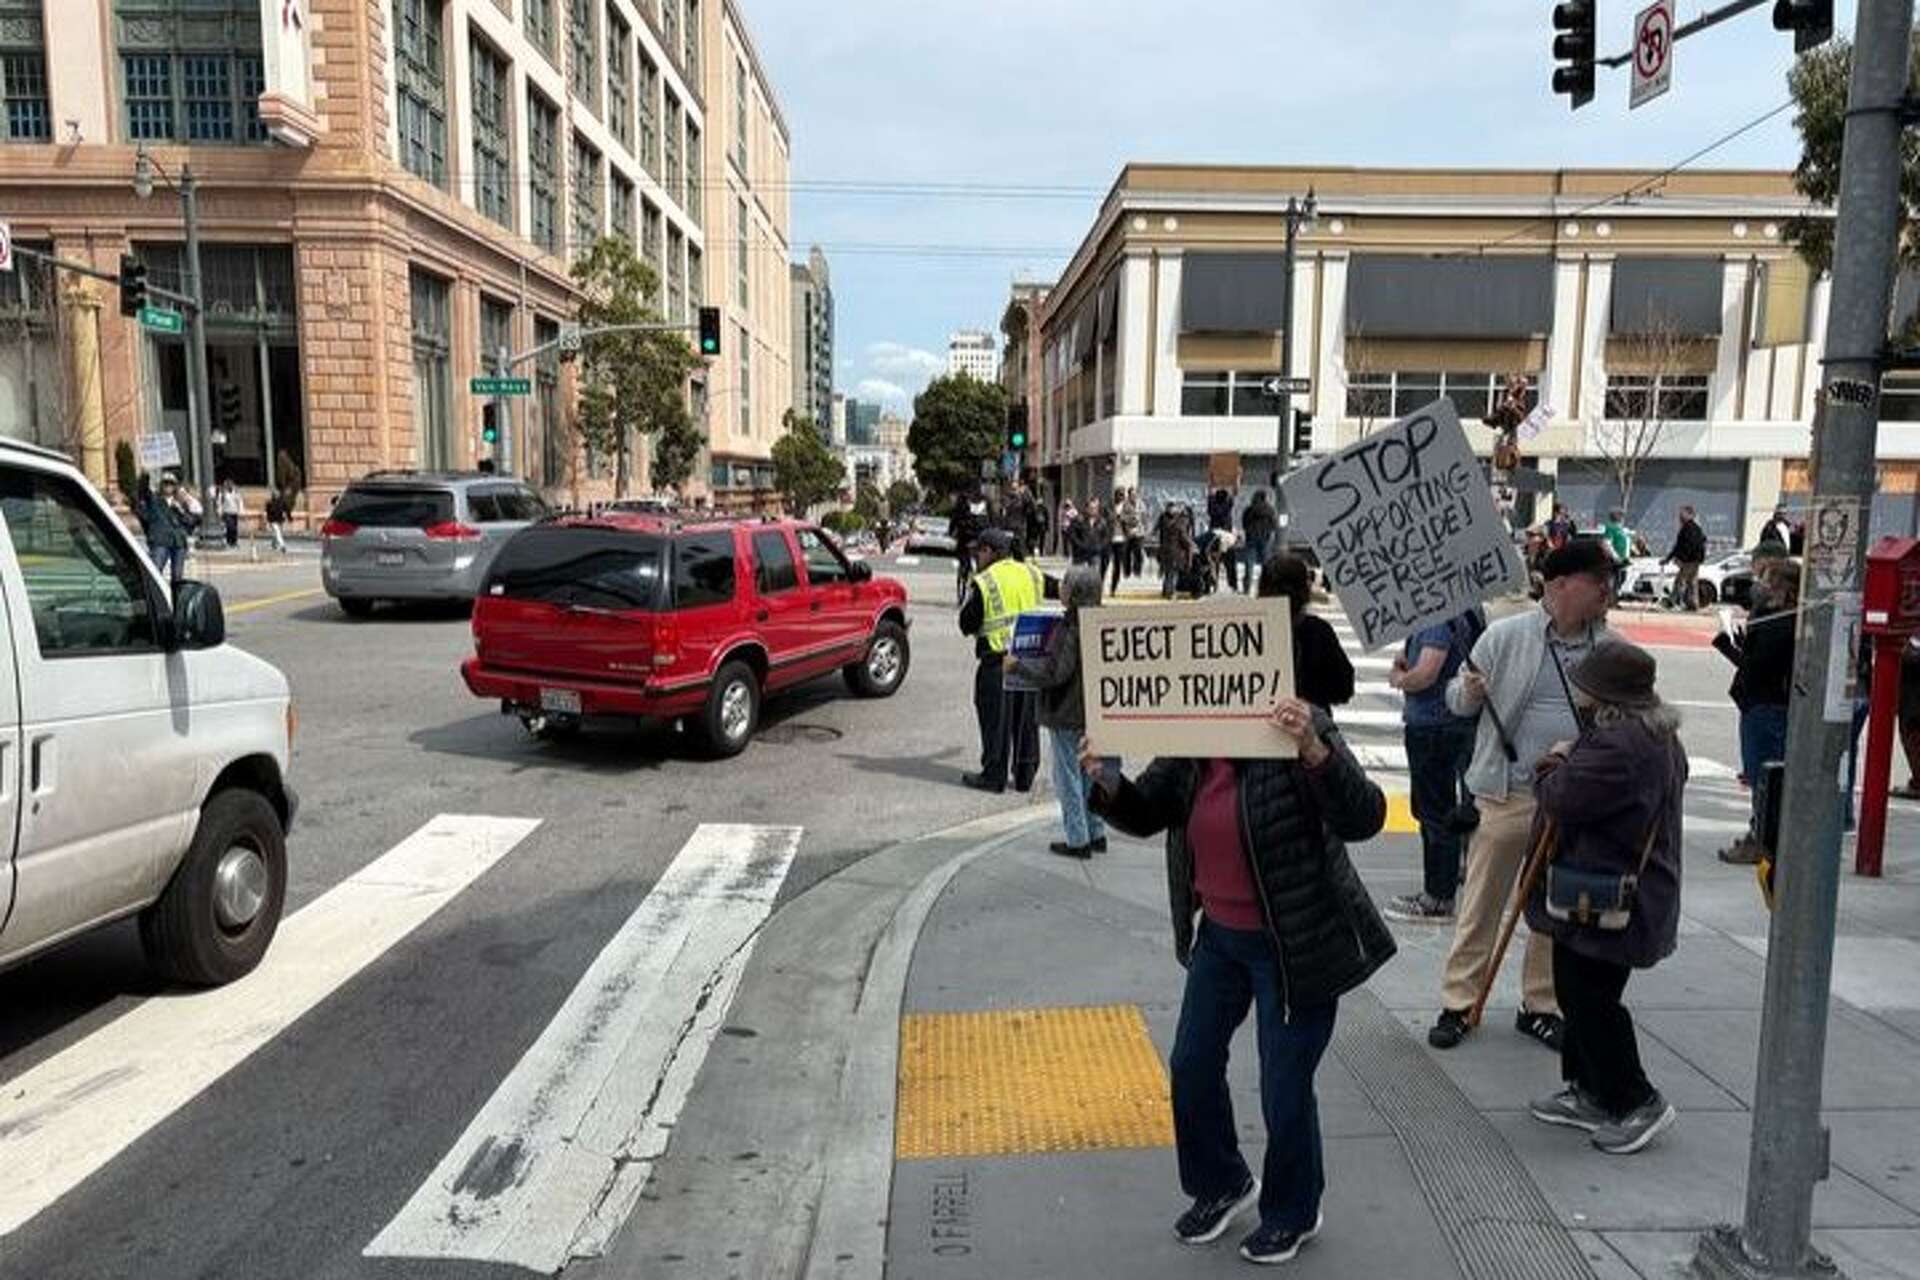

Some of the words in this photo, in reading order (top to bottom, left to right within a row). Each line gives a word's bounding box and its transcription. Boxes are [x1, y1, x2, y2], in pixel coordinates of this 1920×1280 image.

[1316, 415, 1438, 526] STOP
[1317, 462, 1470, 563] SUPPORTING
[1335, 497, 1473, 587] GENOCIDE!
[1364, 541, 1453, 602] FREE
[1362, 547, 1508, 644] PALESTINE!
[1100, 625, 1176, 662] EJECT
[1191, 620, 1264, 660] ELON
[1100, 675, 1171, 708] DUMP
